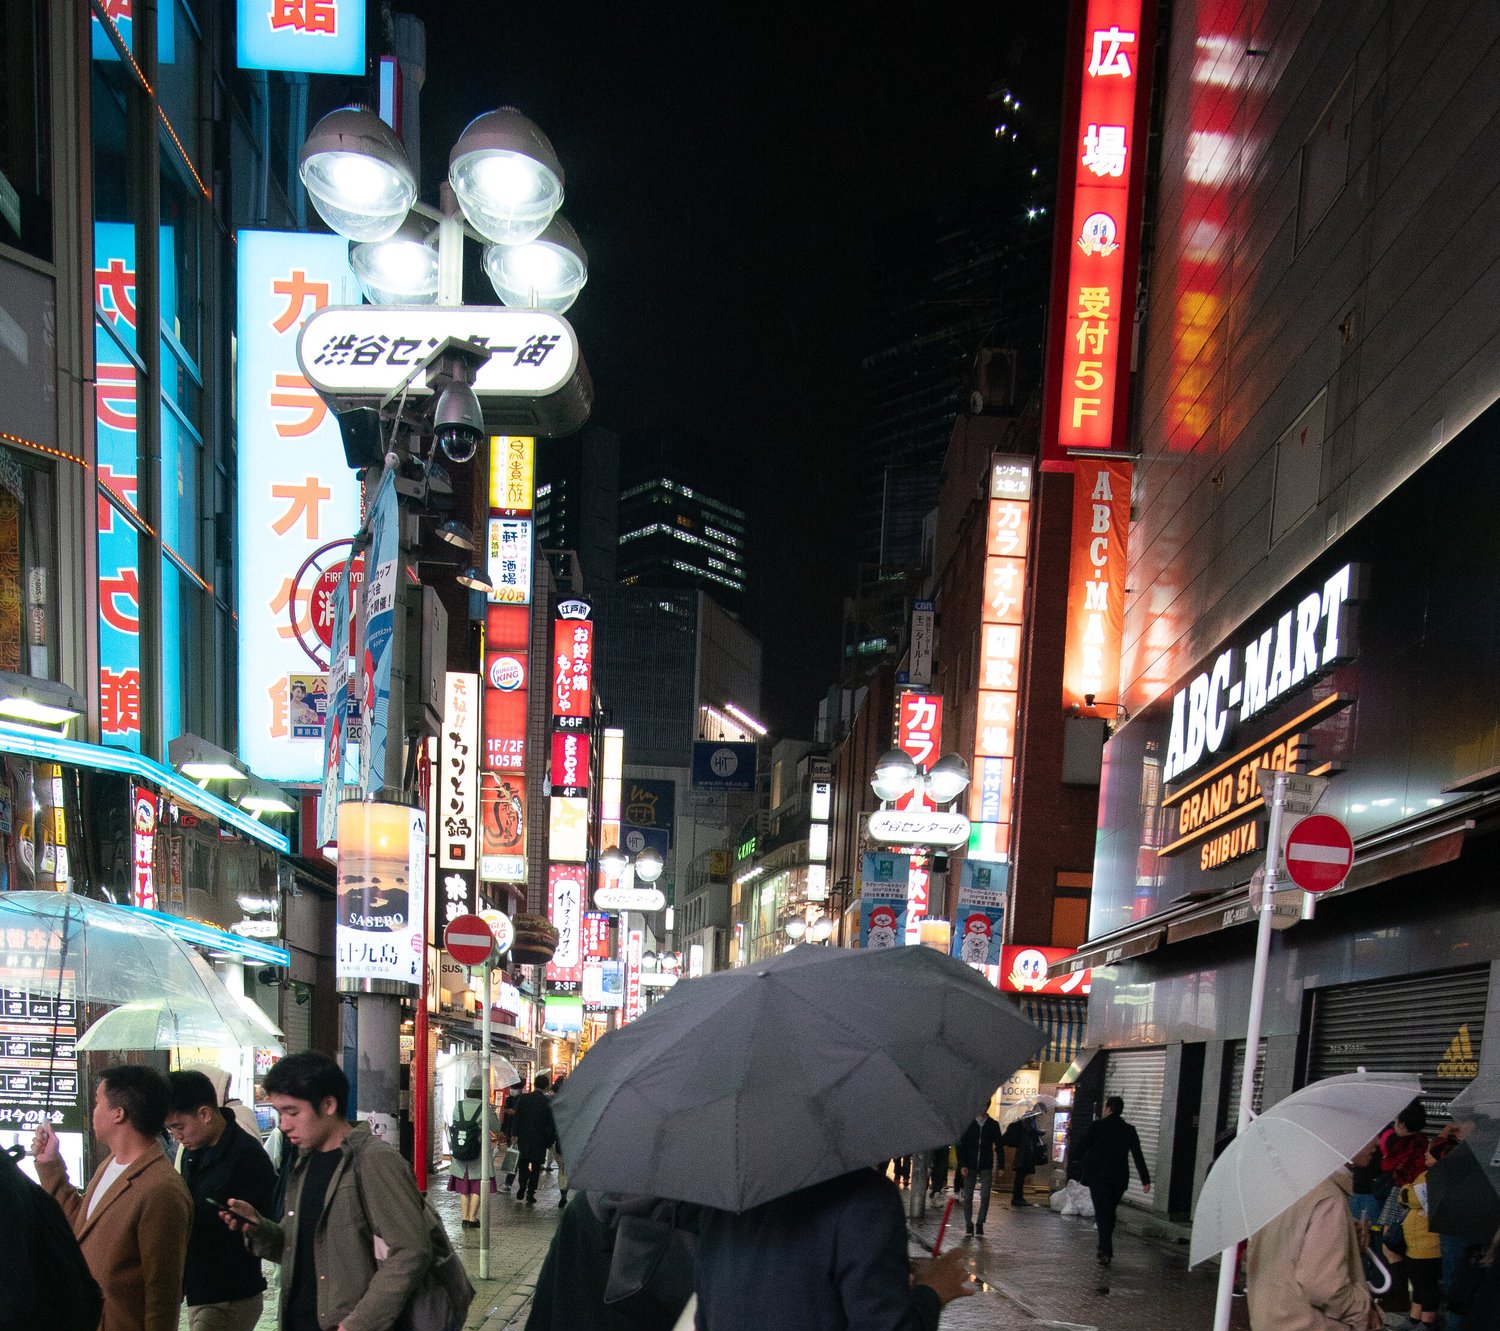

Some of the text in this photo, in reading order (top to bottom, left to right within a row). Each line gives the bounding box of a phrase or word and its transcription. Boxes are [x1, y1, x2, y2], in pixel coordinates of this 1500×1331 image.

[1071, 287, 1112, 428] 受付5F
[508, 440, 524, 503] 鳥貴族
[995, 465, 1030, 477] センター街
[572, 627, 590, 692] お好み焼
[495, 665, 519, 676] BURGER
[496, 671, 519, 683] KING
[1163, 564, 1350, 784] ABC-MART
[556, 654, 571, 712] もんじゃ
[488, 739, 524, 752] 1F/2F
[488, 754, 523, 768] 105席
[445, 732, 472, 838] ちりとり鍋
[563, 787, 577, 797] 4F
[1179, 772, 1233, 836] GRAND
[1201, 820, 1257, 871] SHIBUYA
[350, 912, 404, 928] SASEBO
[1222, 907, 1249, 927] ABC-MART
[441, 964, 464, 973] SUS
[1437, 1063, 1477, 1077] adidas
[1002, 1087, 1037, 1096] LOCKER
